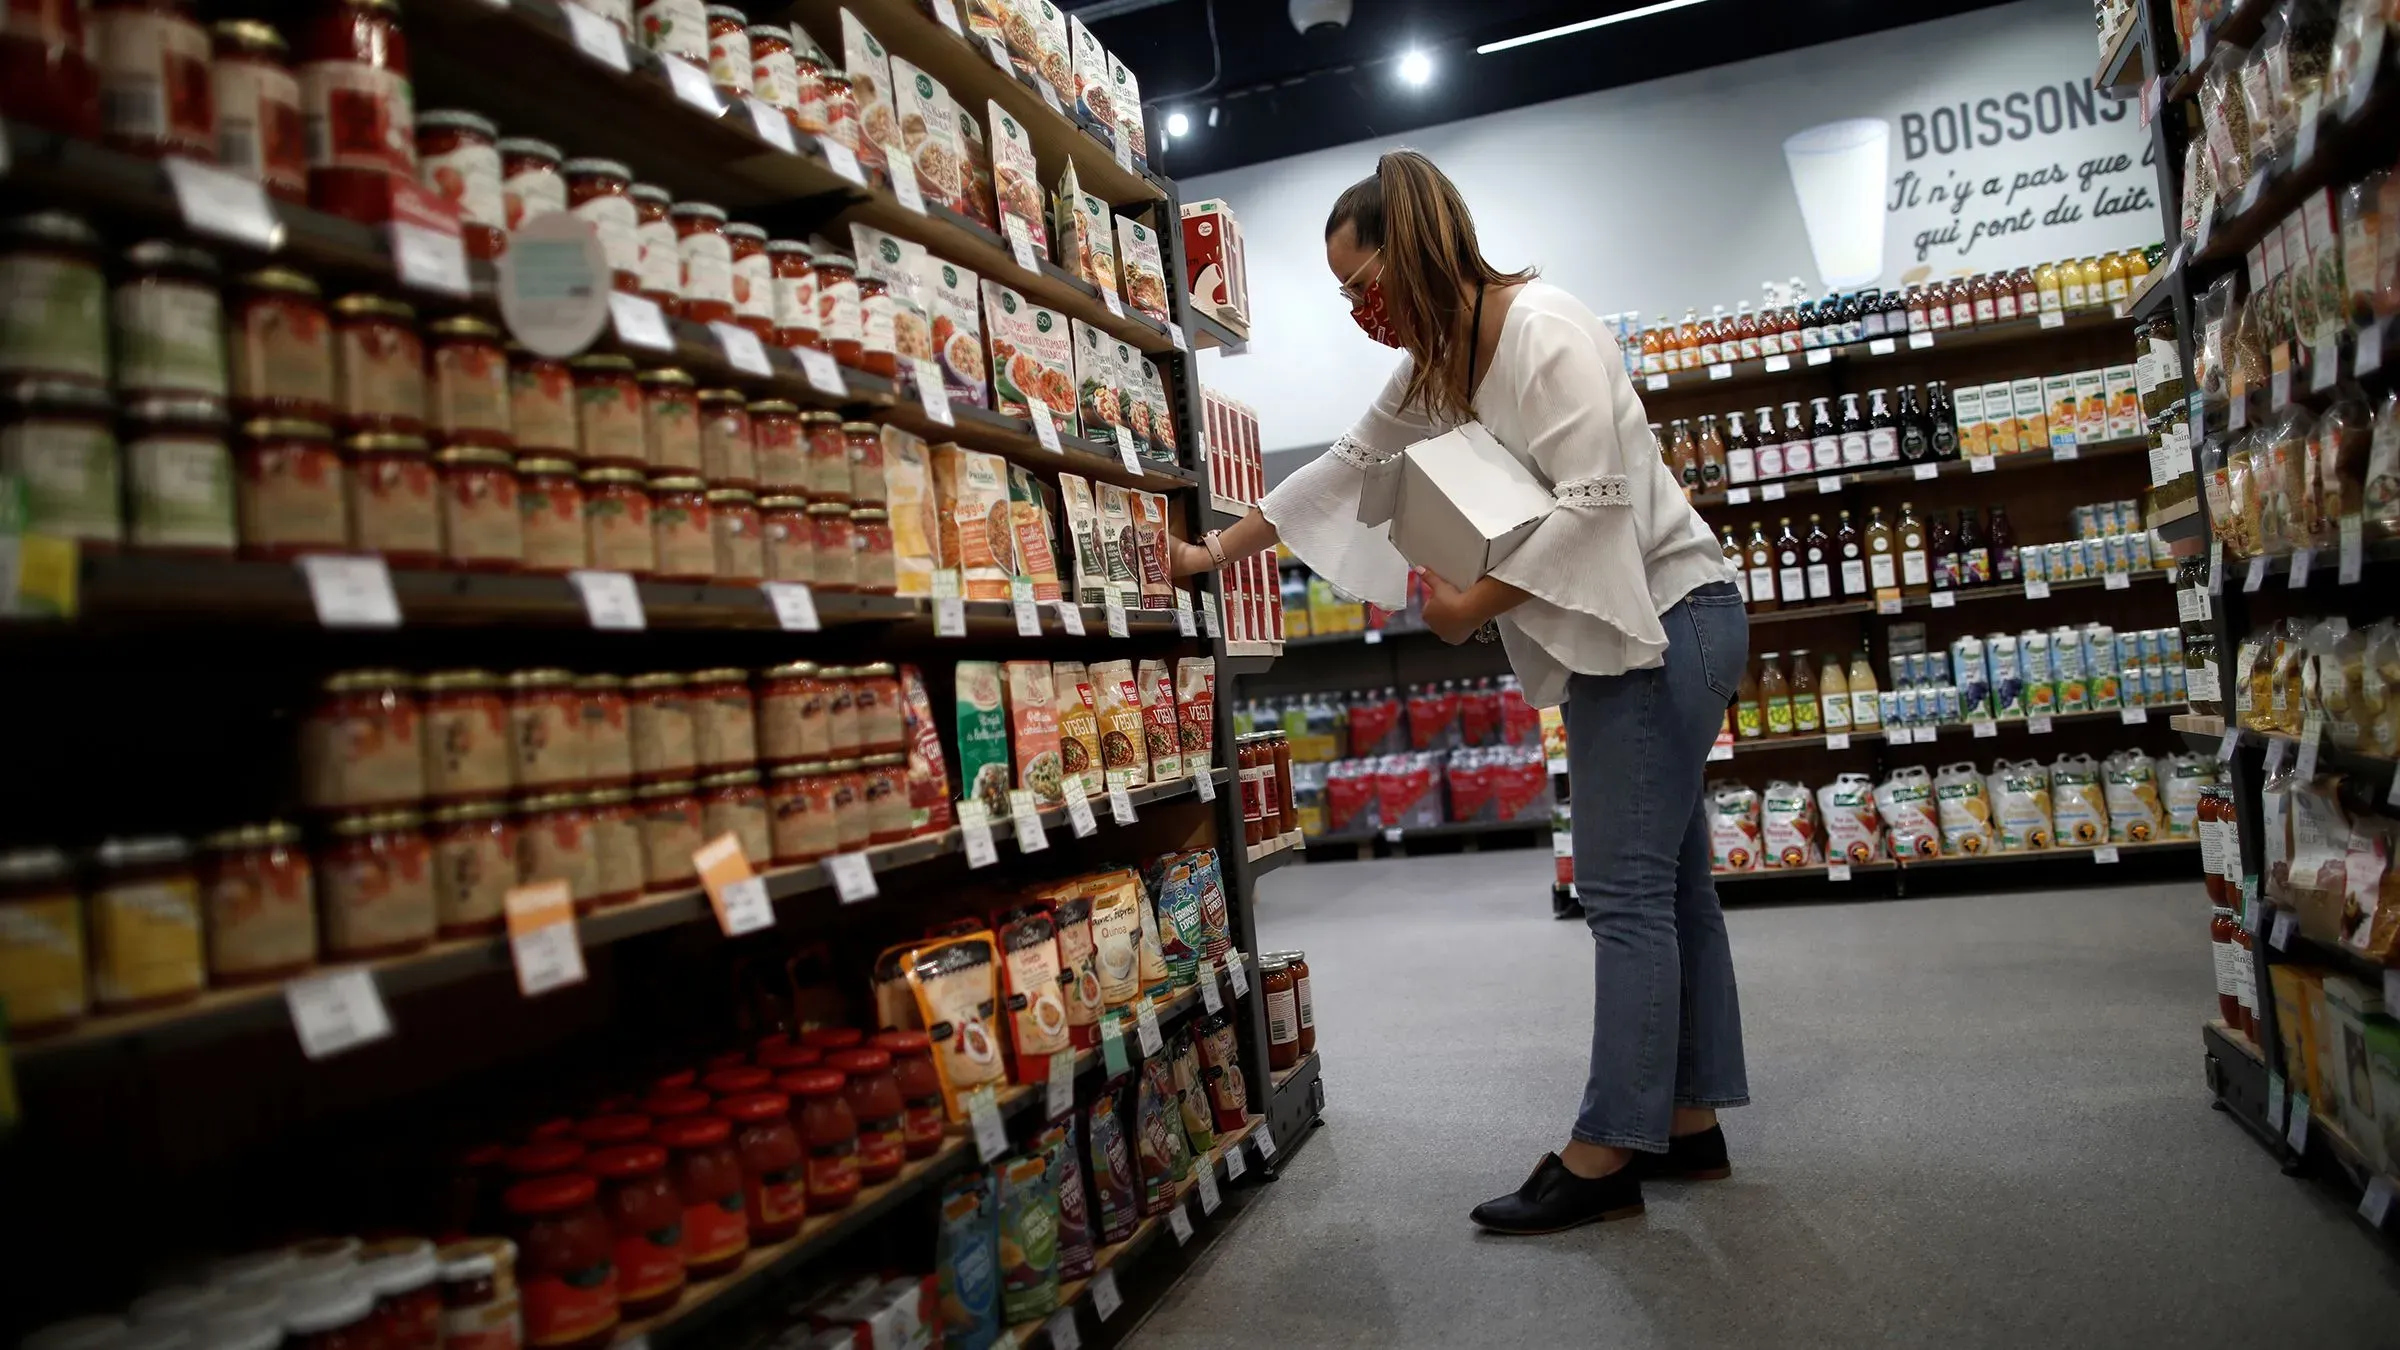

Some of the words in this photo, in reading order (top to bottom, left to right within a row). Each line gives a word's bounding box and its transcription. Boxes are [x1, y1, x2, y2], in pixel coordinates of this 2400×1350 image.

[1901, 76, 2127, 161] BOISSONS
[1887, 170, 1922, 212] Il
[1927, 171, 1973, 214] n'y
[1981, 173, 2004, 196] a
[2004, 162, 2070, 206] pas
[2077, 152, 2133, 192] que
[1914, 222, 1962, 261] qui
[1957, 210, 2036, 255] font
[2043, 194, 2083, 226] du
[2093, 186, 2156, 218] lait.
